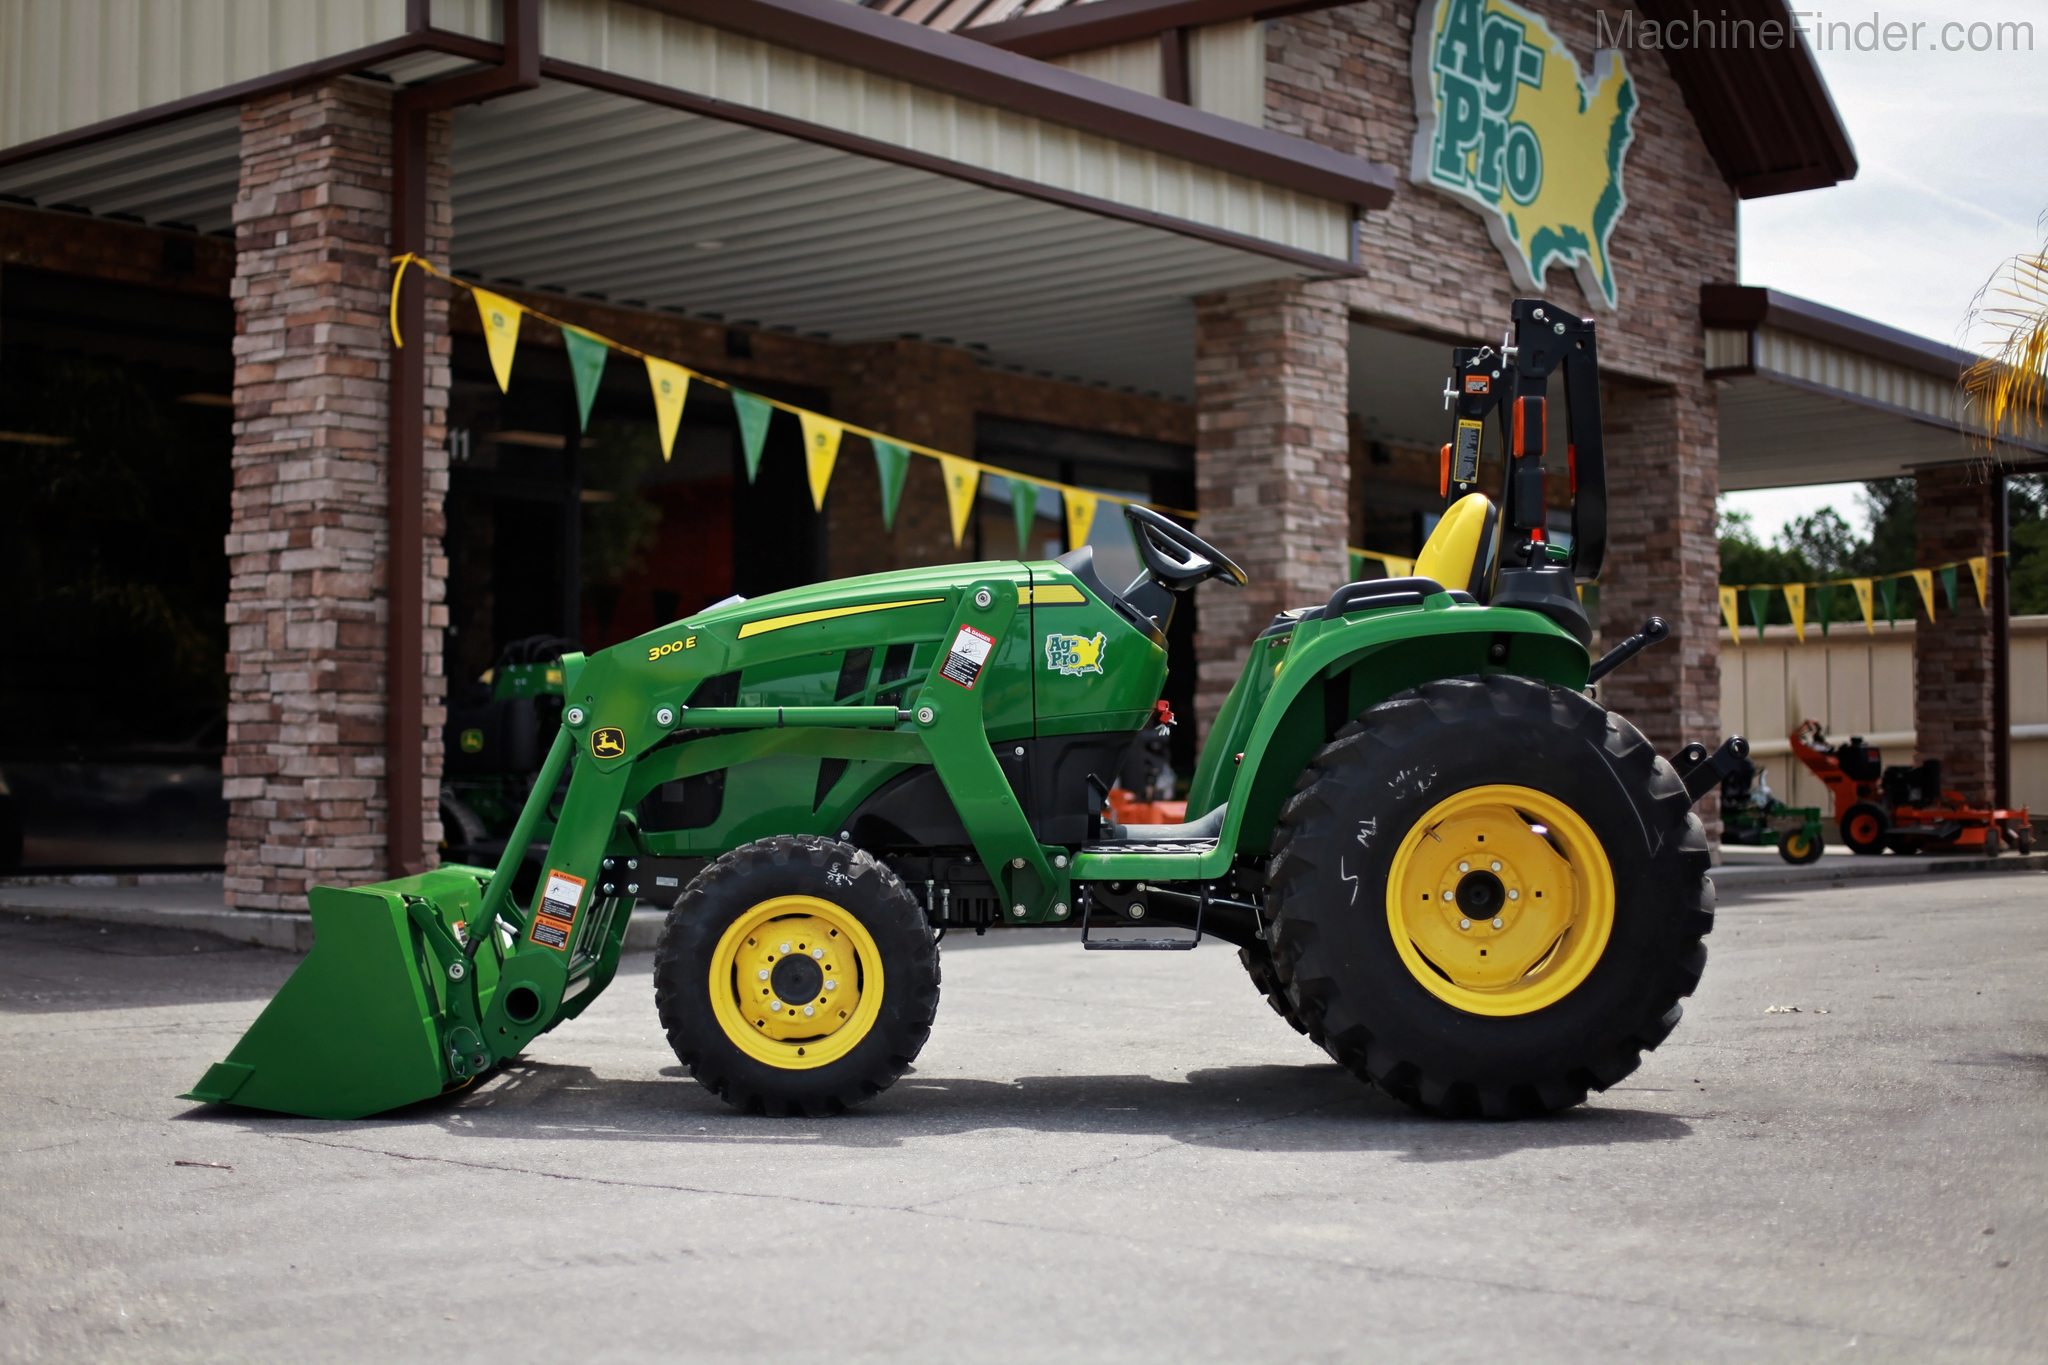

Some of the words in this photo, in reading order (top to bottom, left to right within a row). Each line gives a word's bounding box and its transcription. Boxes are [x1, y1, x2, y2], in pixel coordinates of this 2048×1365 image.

[1435, 0, 1543, 114] Ag-
[1434, 70, 1542, 204] Pro
[971, 629, 992, 643] DANGER
[1049, 635, 1078, 653] Ag-
[1050, 650, 1081, 667] Pro
